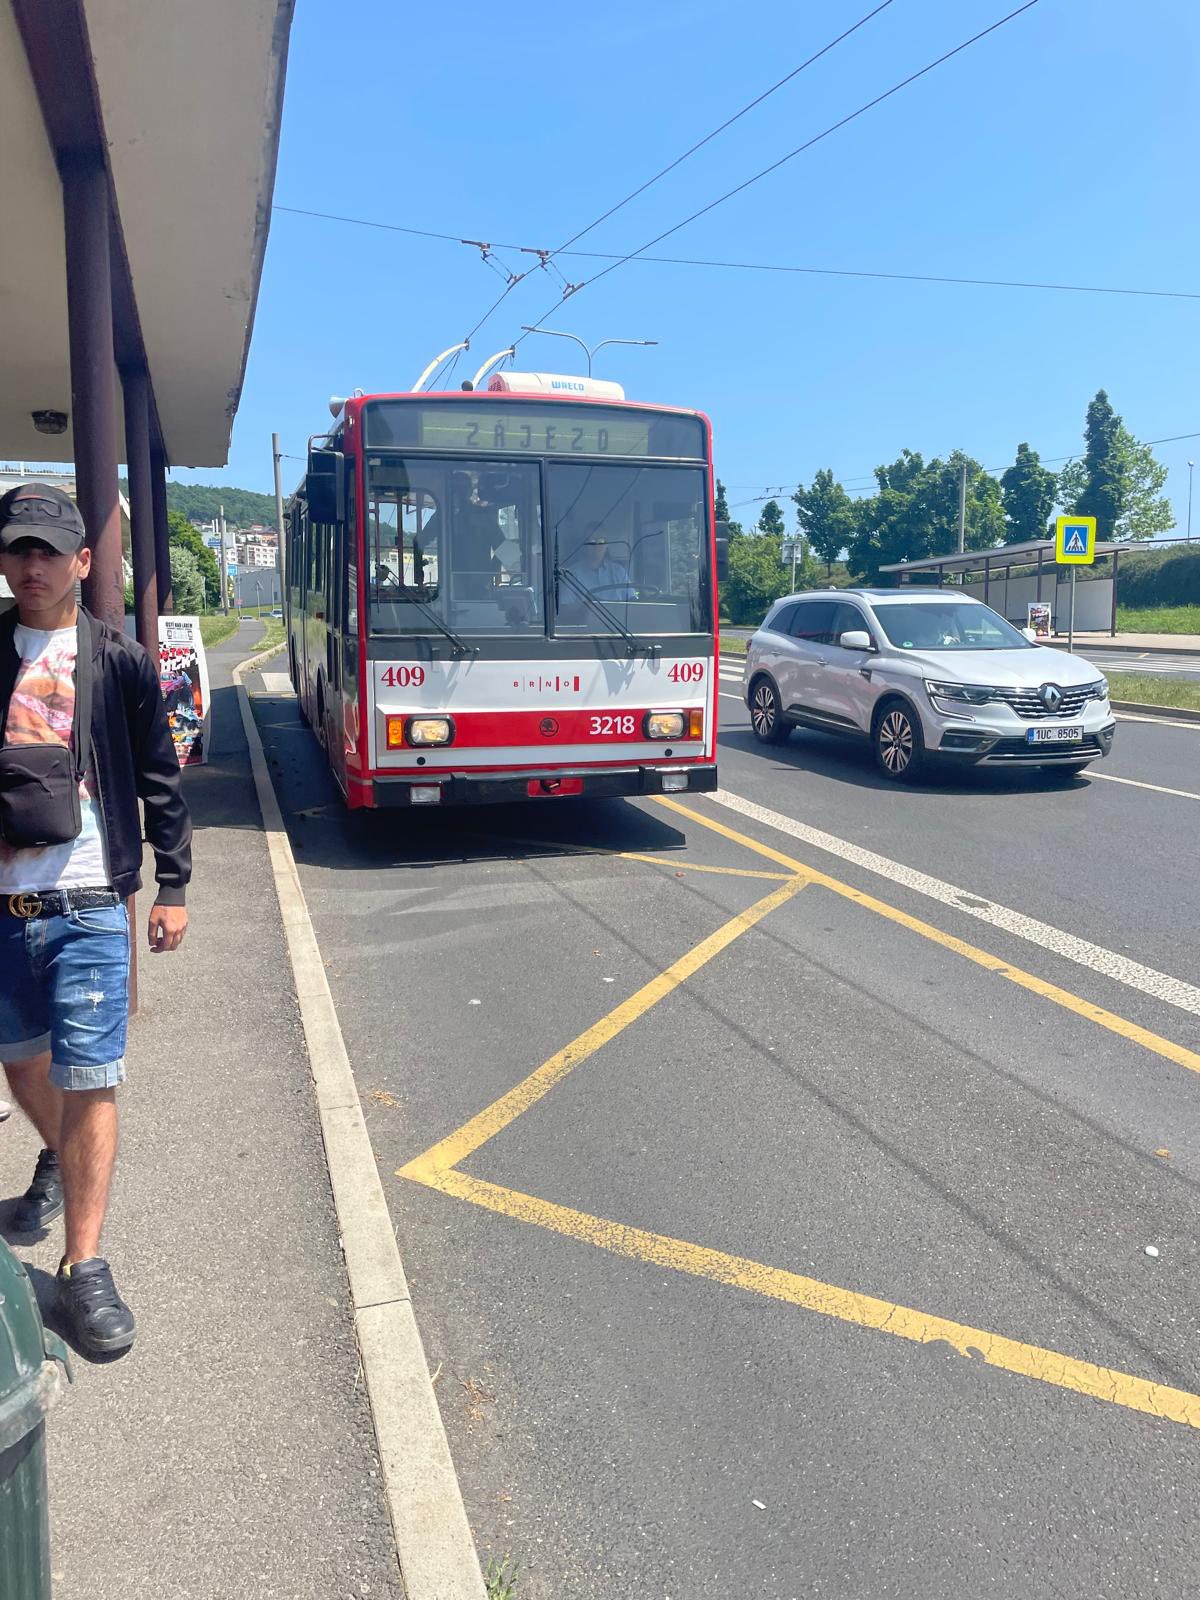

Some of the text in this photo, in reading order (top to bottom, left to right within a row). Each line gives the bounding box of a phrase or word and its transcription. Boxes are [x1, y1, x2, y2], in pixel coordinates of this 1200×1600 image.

[551, 380, 584, 391] WAECO
[381, 666, 425, 688] 409
[667, 662, 704, 683] 409
[589, 715, 635, 736] 3218
[1036, 729, 1052, 740] 1UC
[1057, 728, 1079, 739] 8505
